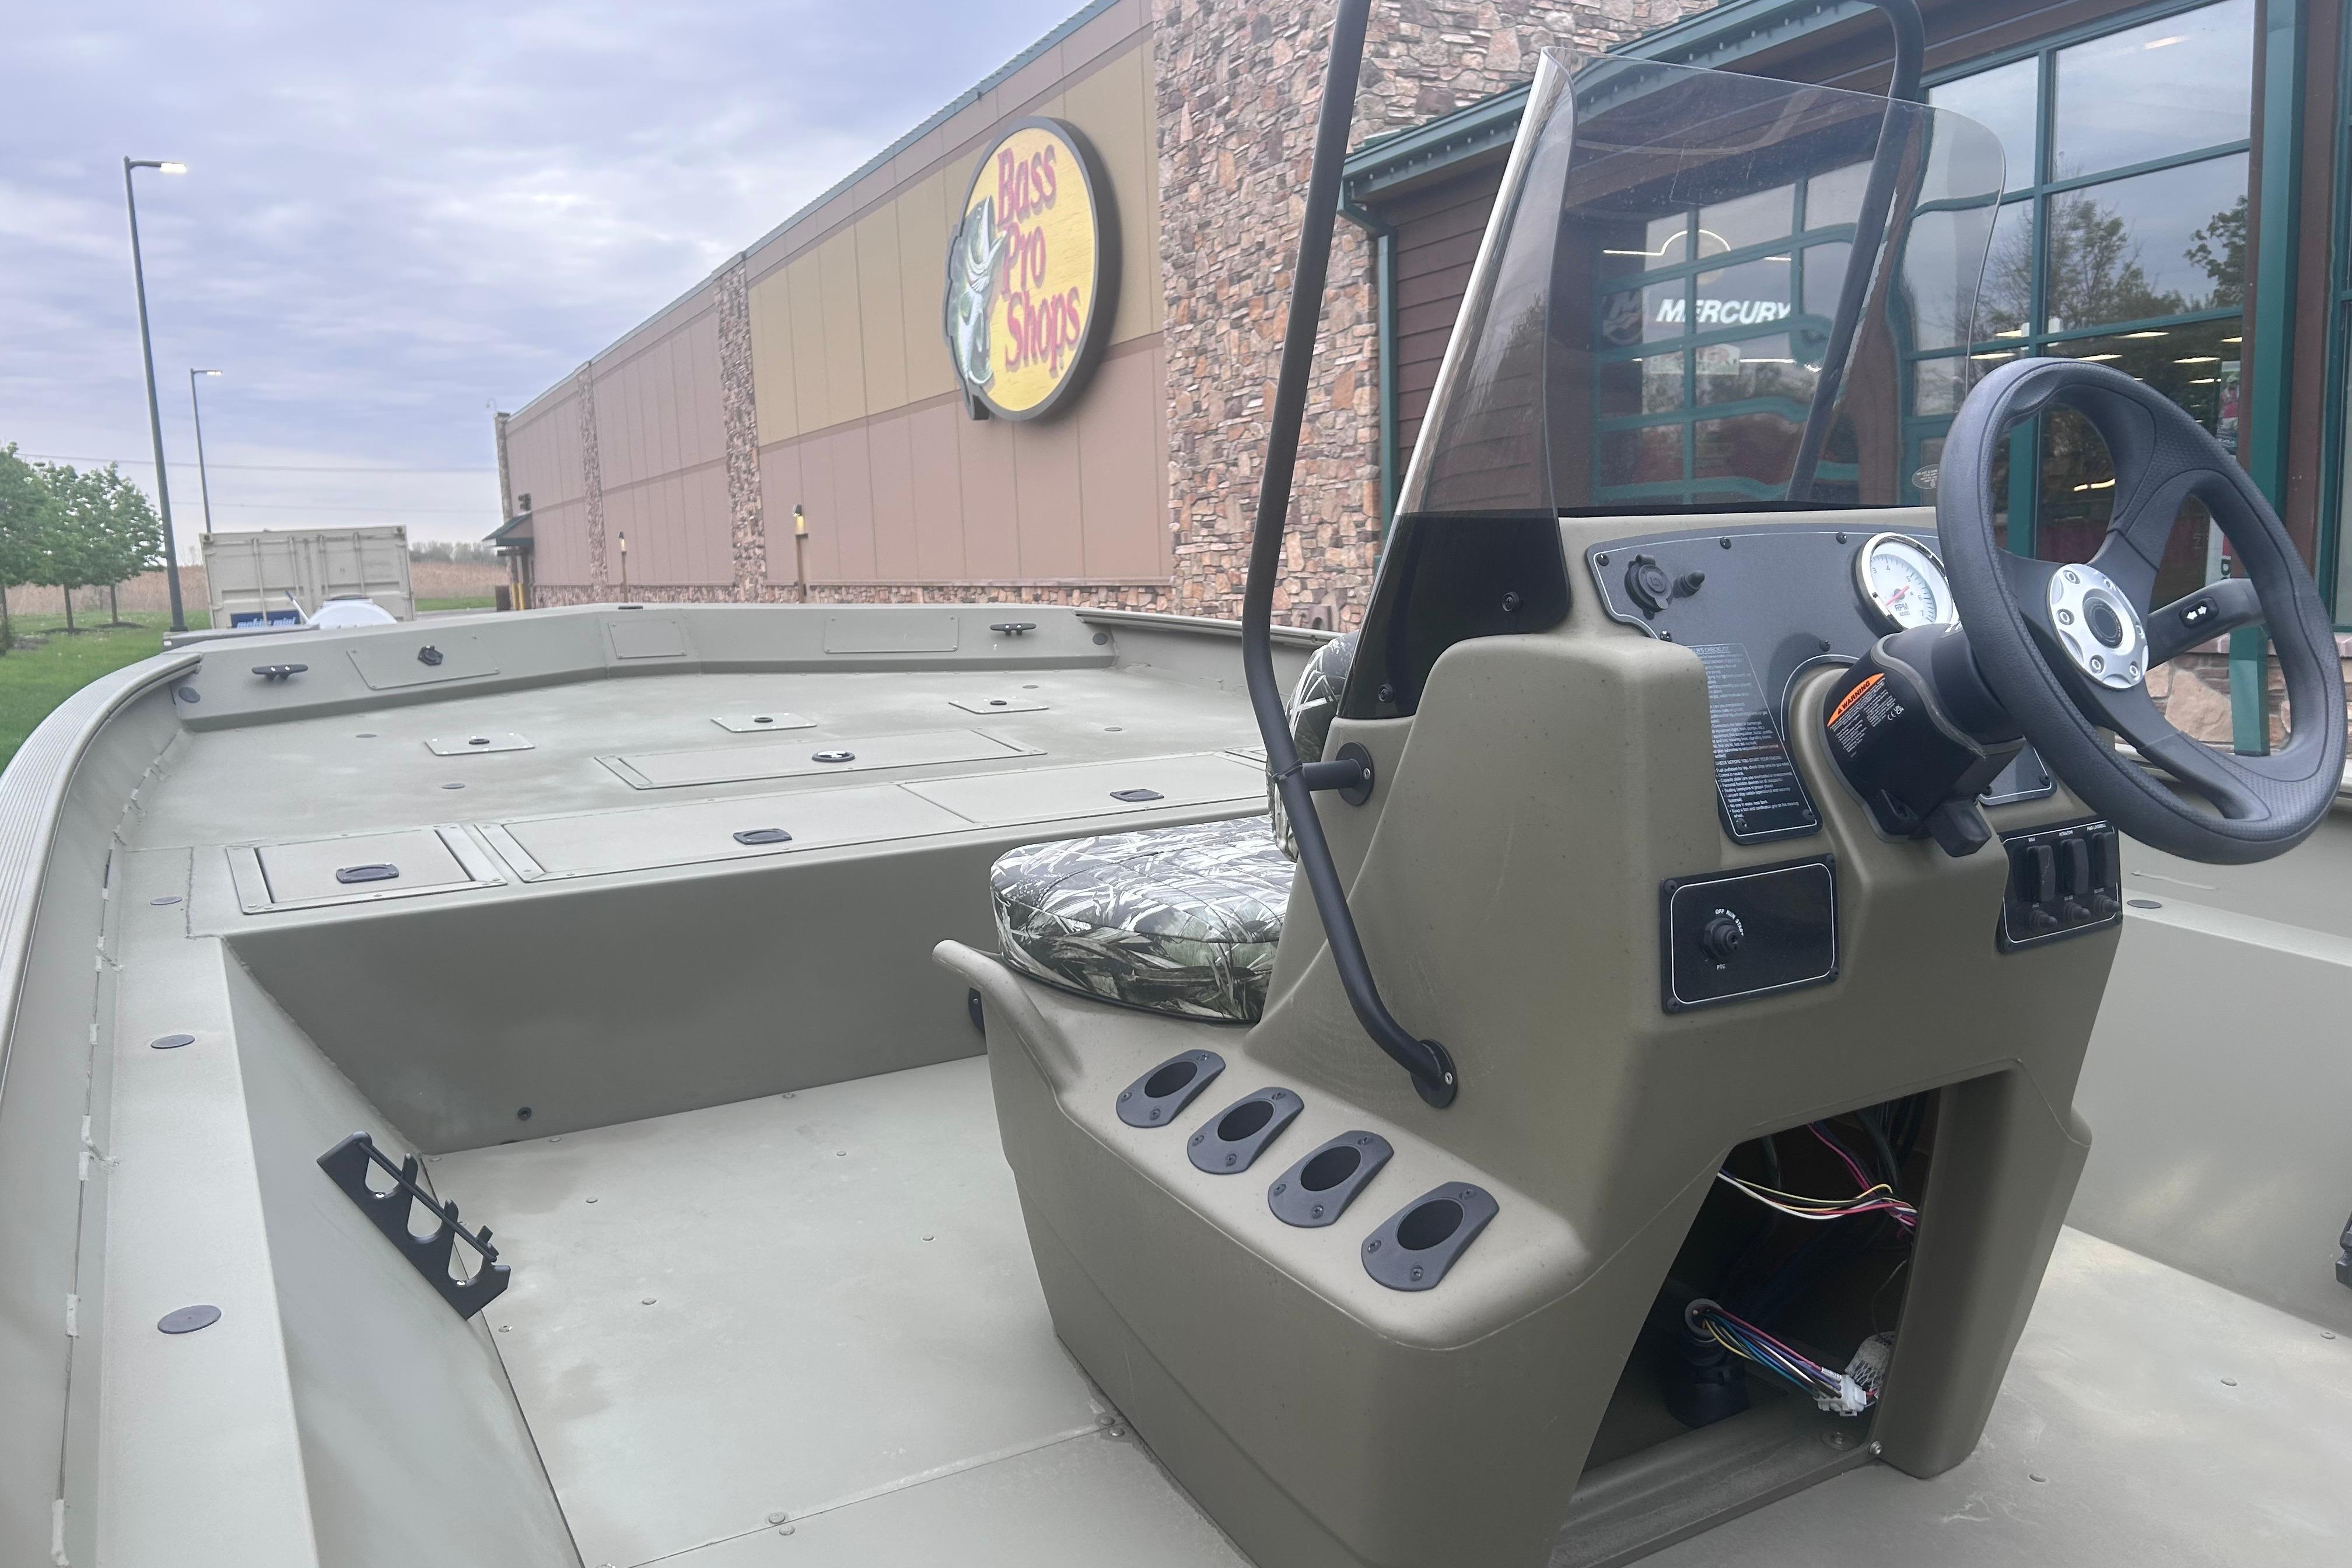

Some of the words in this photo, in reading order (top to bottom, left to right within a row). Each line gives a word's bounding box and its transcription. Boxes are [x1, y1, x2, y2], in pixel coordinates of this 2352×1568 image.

[998, 145, 1056, 223] Bass
[1002, 223, 1046, 293] Pro
[1005, 286, 1080, 374] Shops
[1842, 680, 1871, 709] WARNING
[1726, 909, 1736, 919] RUN
